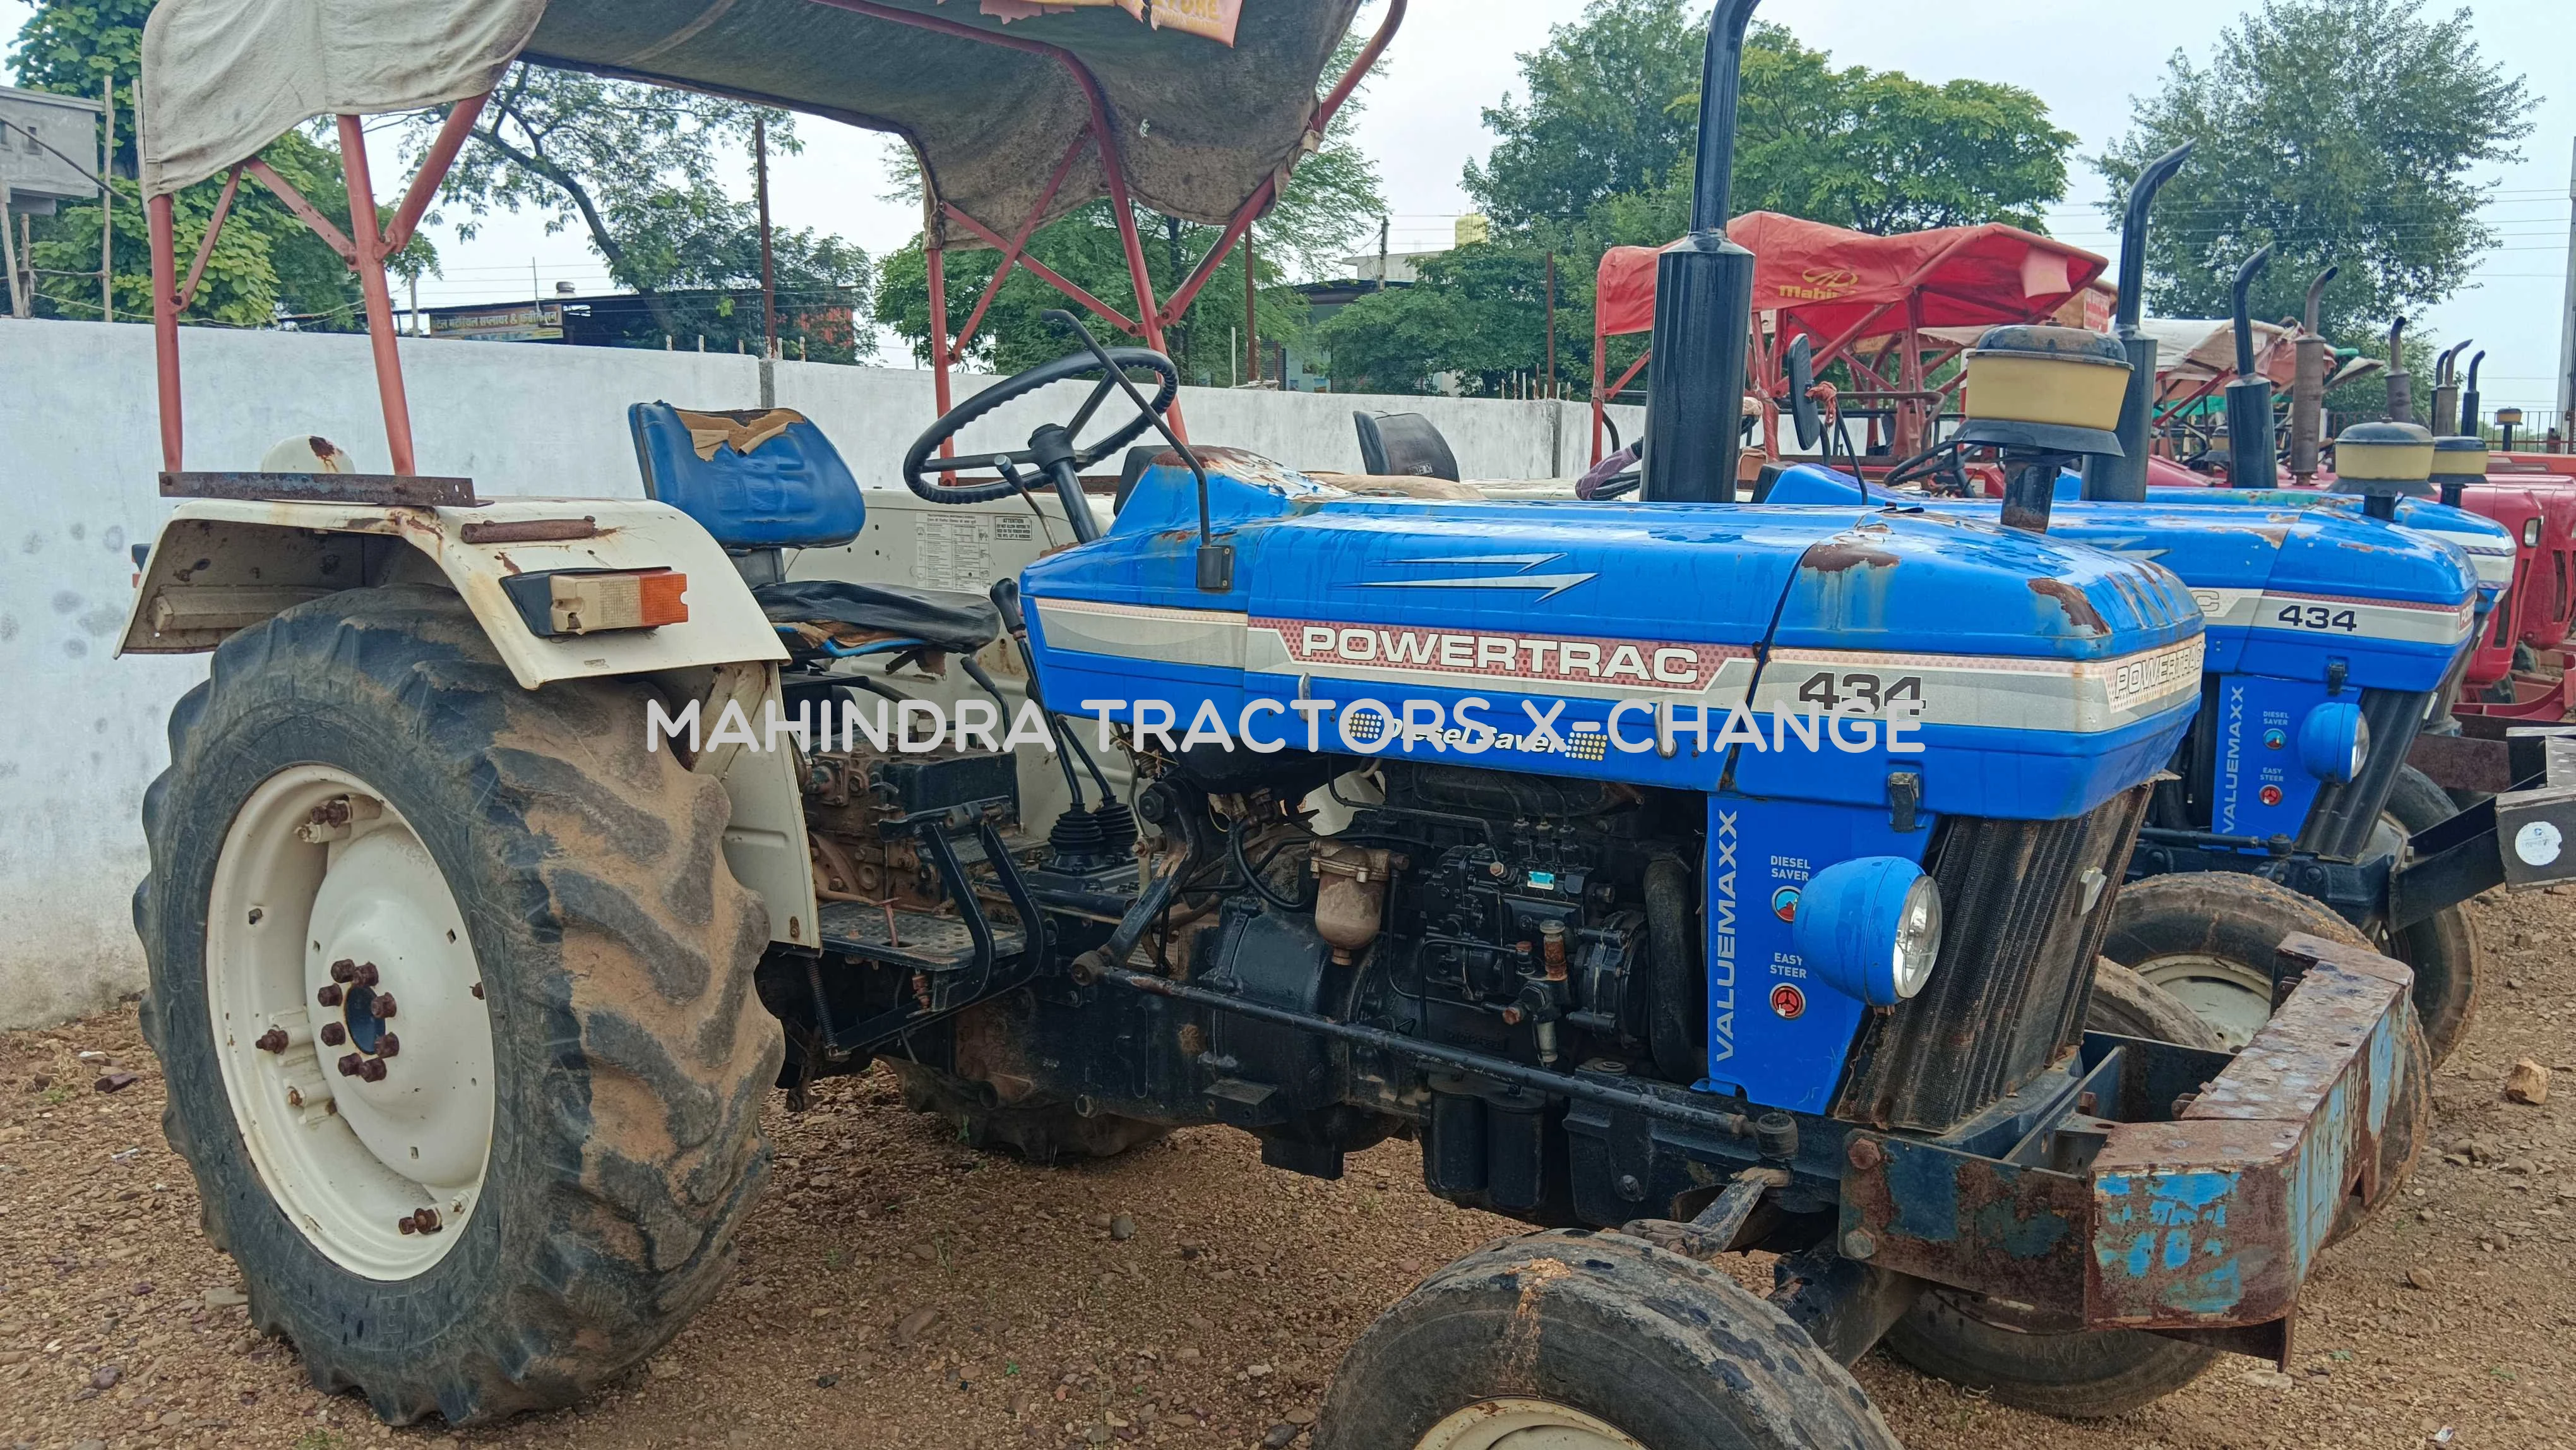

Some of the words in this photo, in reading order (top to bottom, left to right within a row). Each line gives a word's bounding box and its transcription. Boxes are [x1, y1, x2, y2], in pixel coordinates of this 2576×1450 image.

[510, 313, 518, 325] &
[2278, 604, 2357, 632] 434
[1301, 626, 1700, 685] POWERTRAC
[2115, 640, 2203, 699] POWERTRAC
[1798, 671, 1928, 717] 434
[2263, 710, 2289, 719] DIESEL
[1382, 717, 1471, 745] Desel
[2222, 686, 2244, 834] VALUEMAXX
[2260, 774, 2284, 782] STEER
[1770, 855, 1811, 870] DIESEL
[1771, 868, 1809, 882] SAVER
[1716, 809, 1738, 1062] VALUEMAXX
[1774, 952, 1803, 966] EASY
[1770, 964, 1807, 979] STEER
